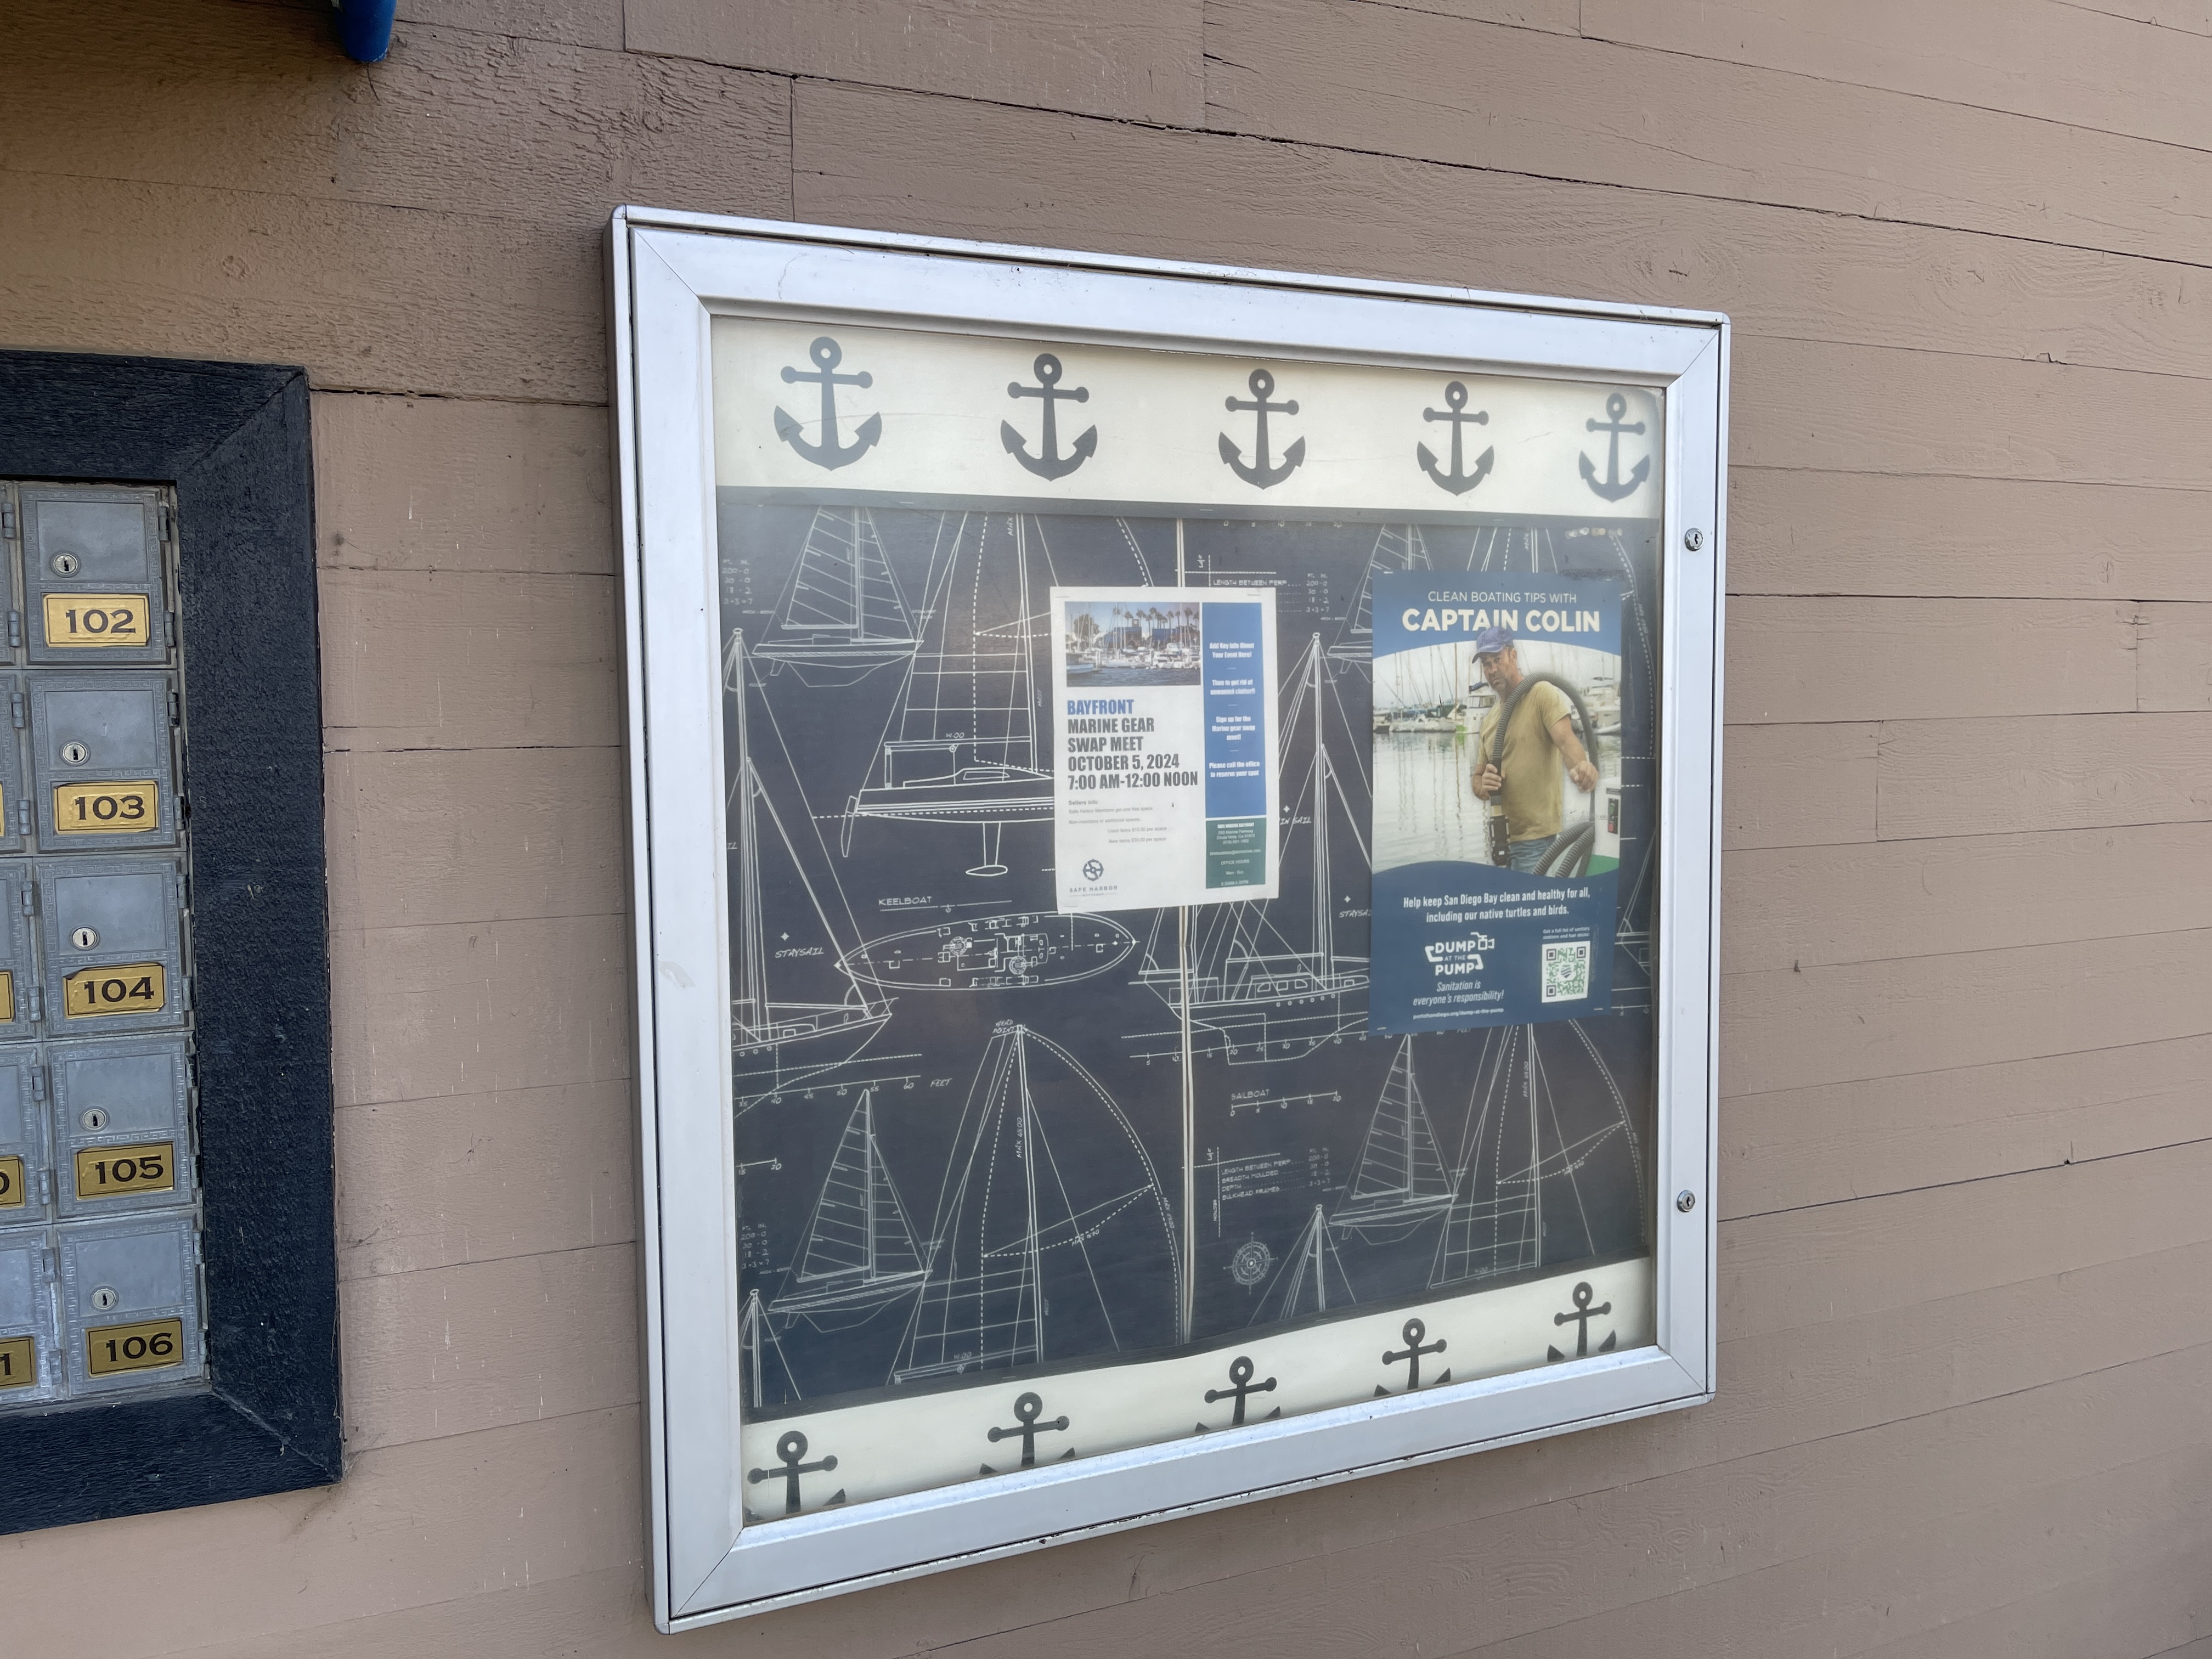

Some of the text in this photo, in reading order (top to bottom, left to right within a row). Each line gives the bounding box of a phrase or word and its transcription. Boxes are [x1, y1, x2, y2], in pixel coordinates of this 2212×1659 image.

[1428, 591, 1577, 603] CLEAN BOATING TIPS WITH
[65, 609, 136, 634] 102
[1402, 608, 1600, 632] CAPTAIN COLIN
[1068, 699, 1134, 715] BAYFRONT
[1068, 718, 1154, 734] MARINE GEAR
[1068, 736, 1143, 753] SWAP MEET
[1068, 754, 1180, 771] OCTOBER 5, 2024
[1068, 771, 1198, 790] 7:00 AM-12:00 NOON
[75, 795, 145, 820] 103
[878, 896, 932, 906] KEELBOAT
[1403, 887, 1590, 909] Help keep San Diego Bay clean and healthy for all,
[1426, 904, 1569, 923] including our native turtles and birds.
[775, 947, 824, 958] STAYSAIL
[1435, 940, 1476, 953] DUMP
[1435, 962, 1475, 976] PUMP
[84, 977, 154, 1004] 104
[1437, 979, 1481, 992] Sanitation is
[1413, 989, 1504, 1007] everyone's responsibility!
[930, 1078, 952, 1087] FEET
[1231, 1088, 1269, 1100] SAILBOAT
[95, 1155, 163, 1184] 105
[1221, 1167, 1243, 1175] LENGTH
[1245, 1163, 1272, 1171] BETWEEN
[1222, 1175, 1250, 1183] BREADTH
[1222, 1186, 1280, 1200] BULKHEAD FRAMES
[106, 1333, 173, 1362] 106
